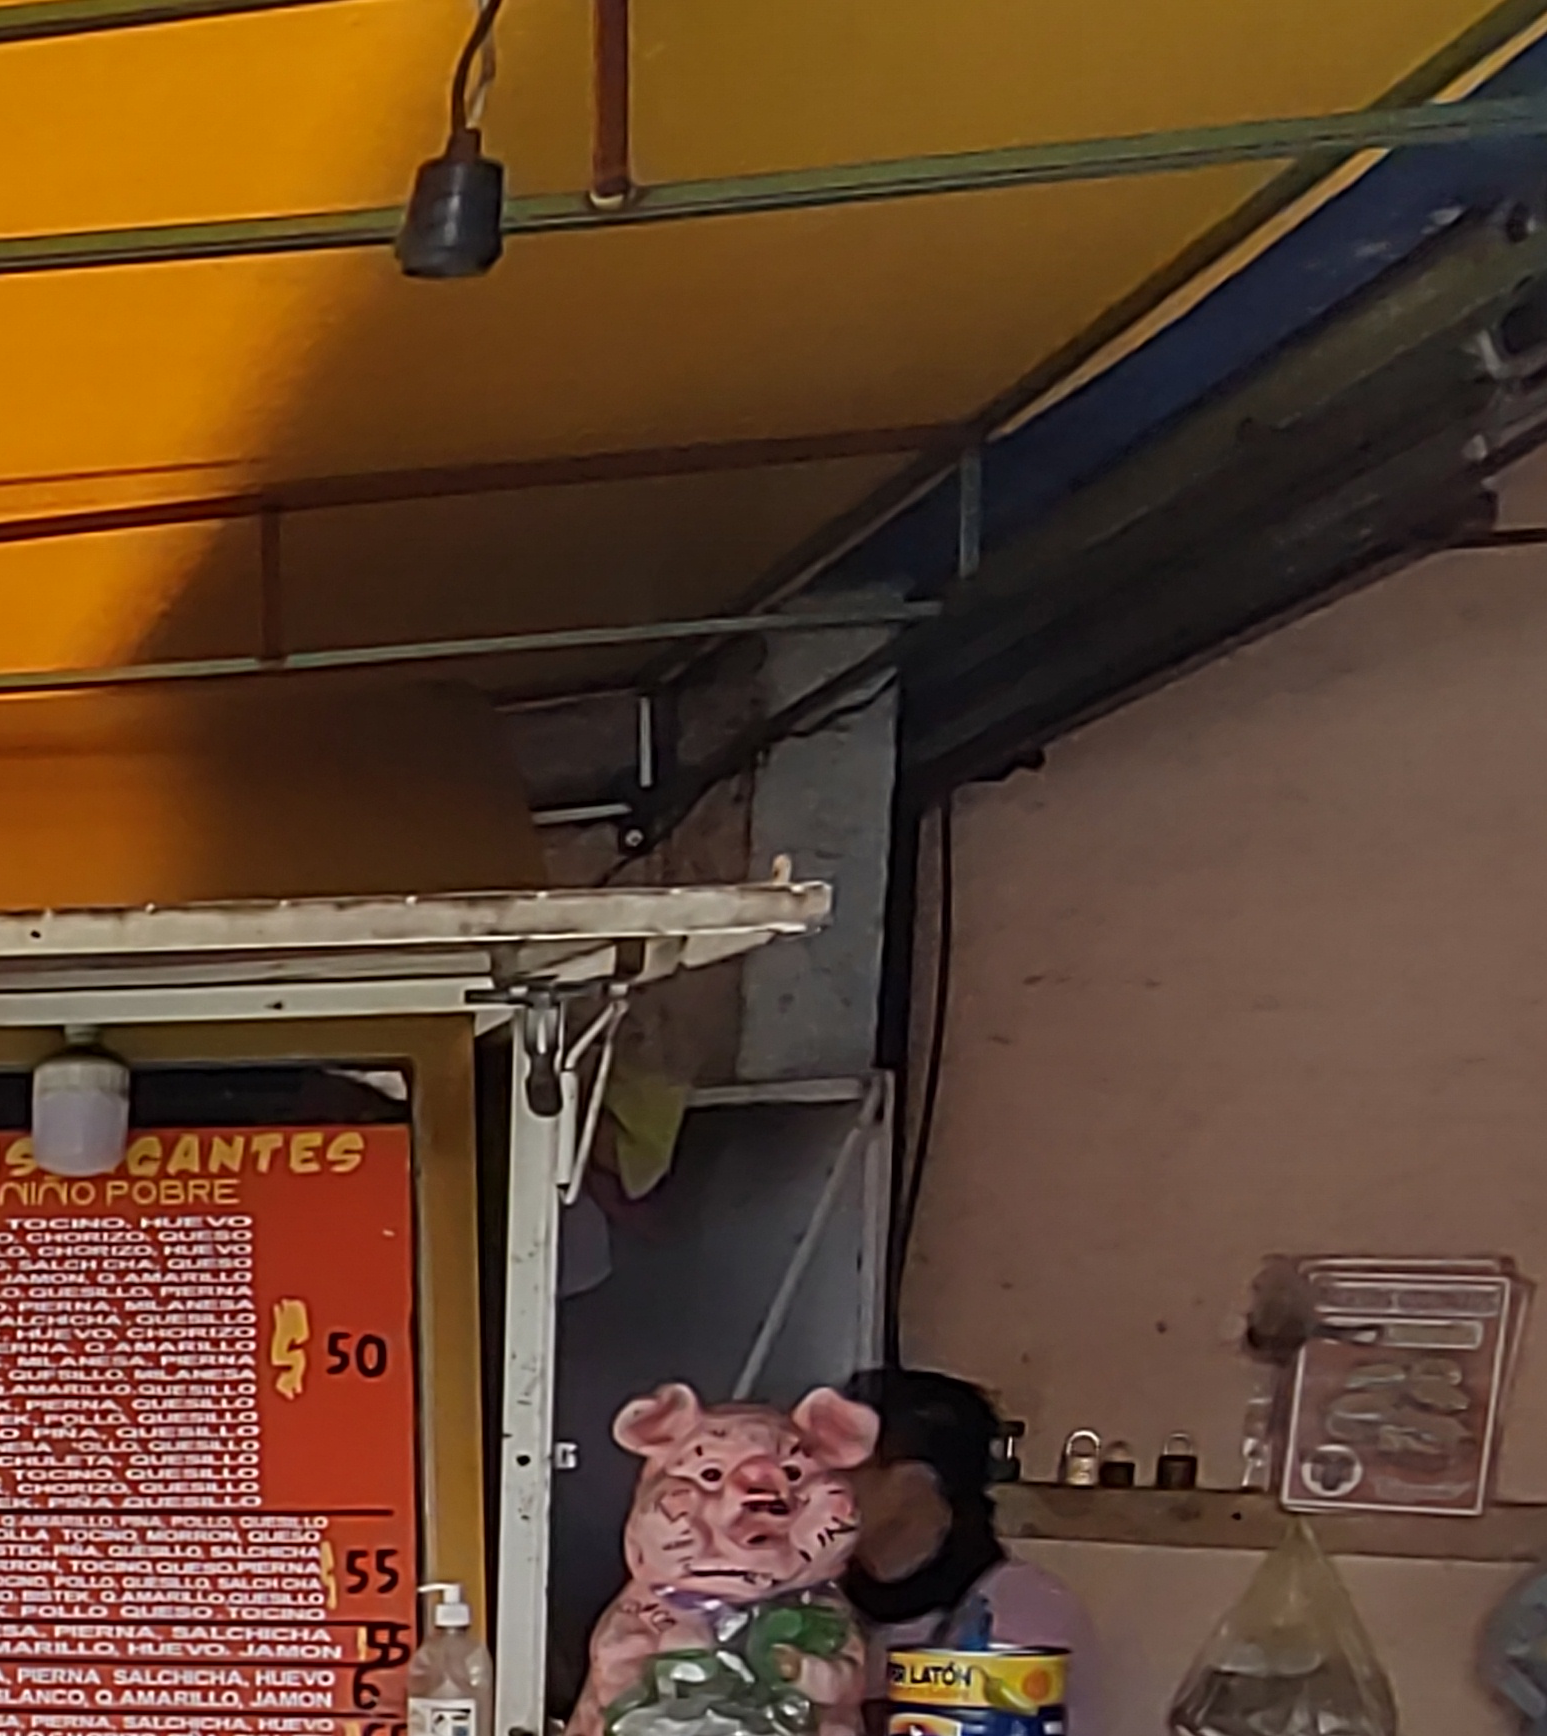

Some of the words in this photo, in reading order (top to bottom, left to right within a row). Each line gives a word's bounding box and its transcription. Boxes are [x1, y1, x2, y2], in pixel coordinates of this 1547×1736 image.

[106, 1178, 241, 1207] POBRE
[140, 1215, 253, 1228] HUEVO
[157, 1229, 253, 1243] QUESO
[135, 1312, 257, 1326] QUESILLO
[126, 1326, 256, 1339] CHORIZO
[325, 1332, 388, 1378] 50
[344, 1547, 400, 1595] 55
[171, 1625, 332, 1642] SALCHICHA
[239, 1644, 342, 1661] JAMON
[255, 1668, 336, 1688] HUEVO
[250, 1690, 332, 1710] JAMON
[258, 1716, 334, 1732] HUEVO
